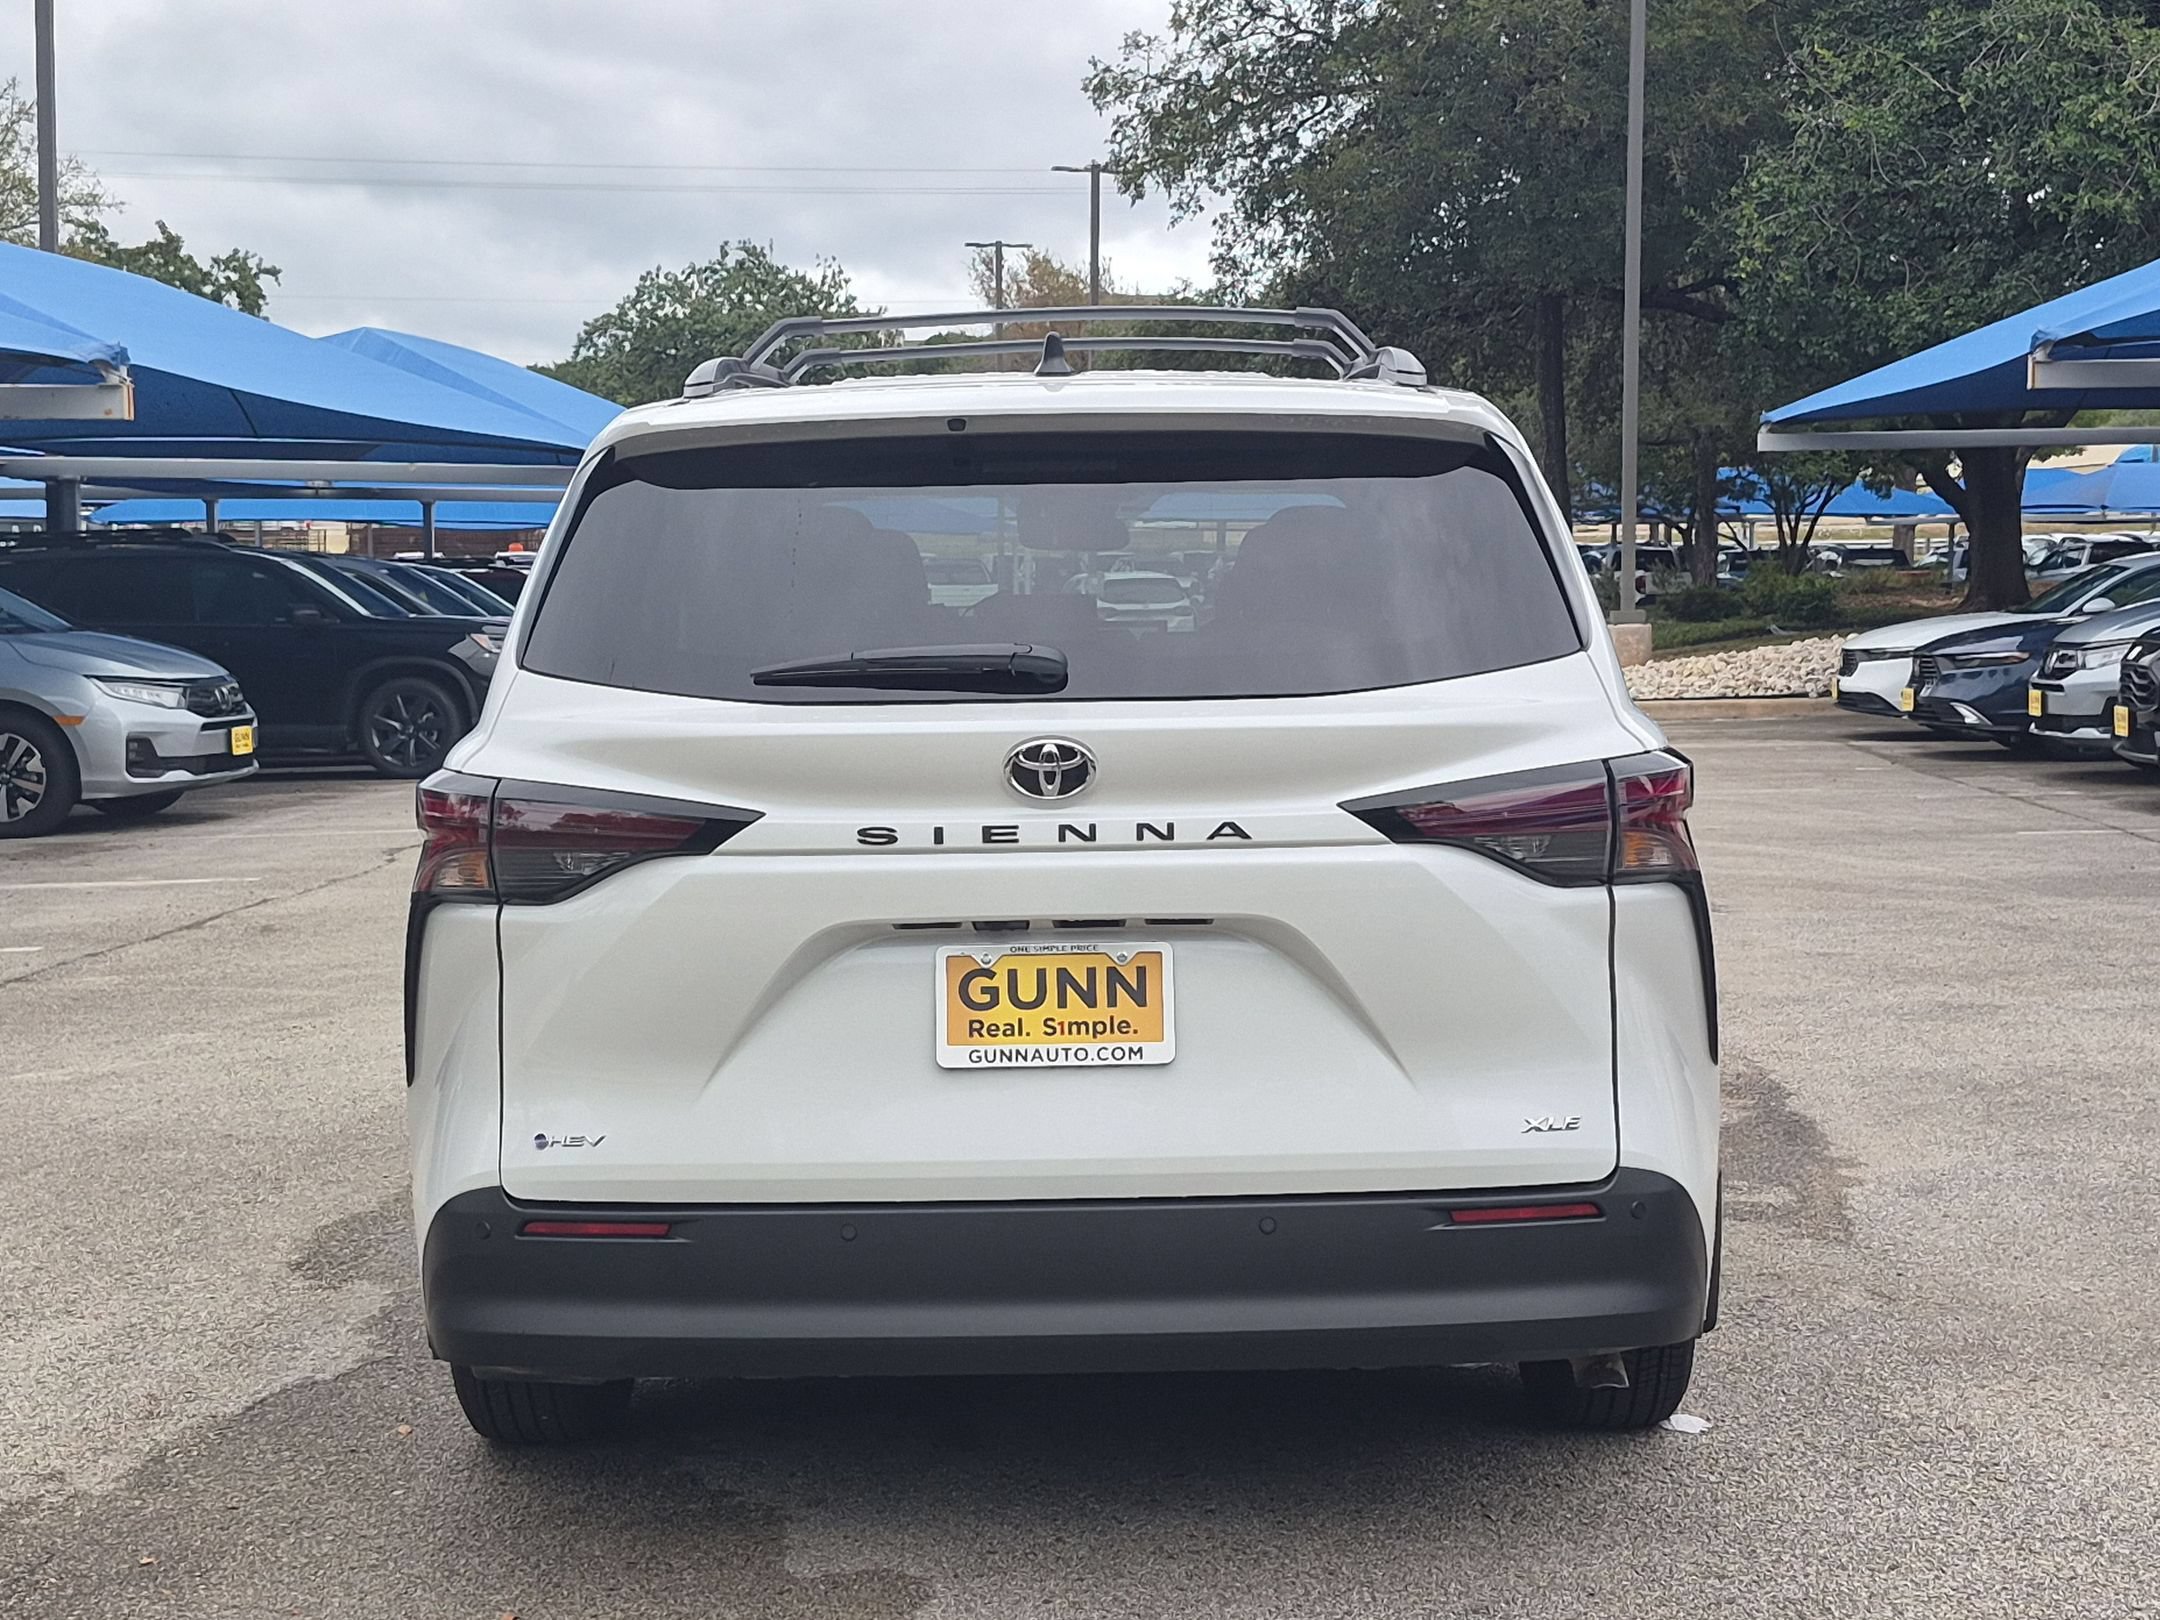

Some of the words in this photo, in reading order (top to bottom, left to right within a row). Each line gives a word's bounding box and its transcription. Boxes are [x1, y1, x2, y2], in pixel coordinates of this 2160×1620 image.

[856, 821, 1253, 846] SIENNA
[957, 966, 1148, 1012] GUNN
[968, 1017, 1031, 1038] Real.
[968, 1046, 1144, 1064] GUNNAUTO.COM
[1520, 1115, 1581, 1133] XLE
[549, 1135, 607, 1148] HEV
